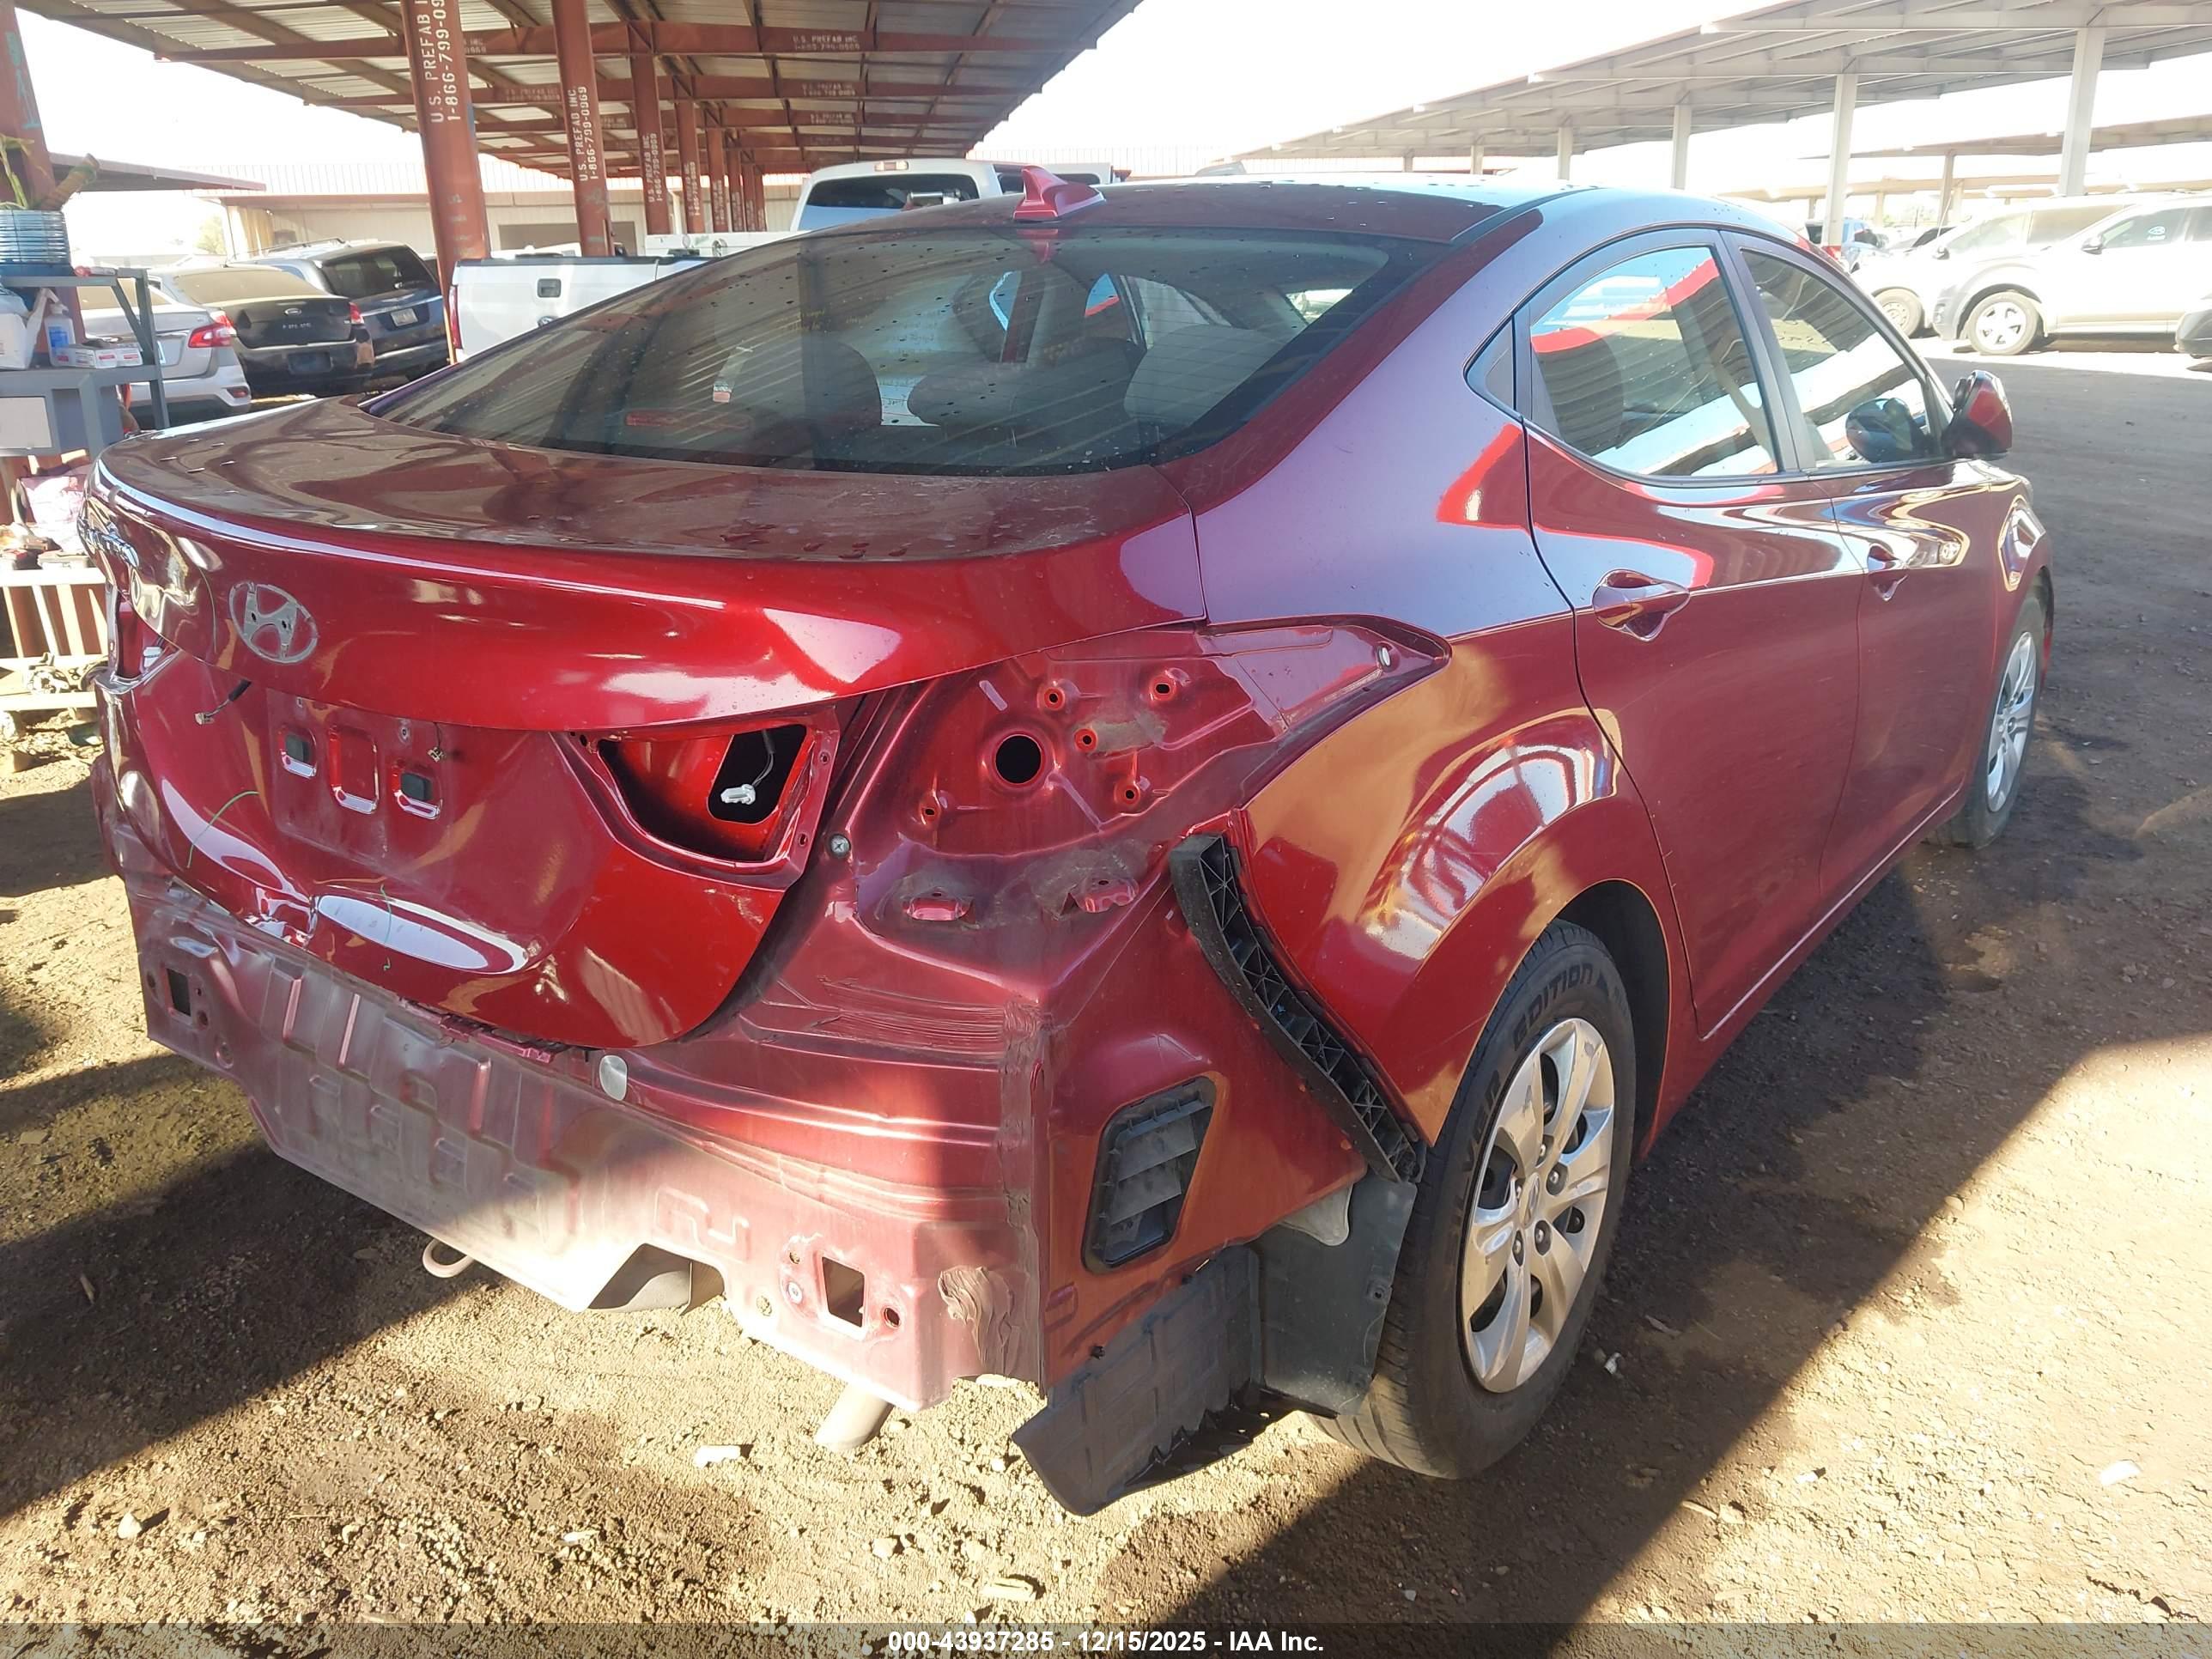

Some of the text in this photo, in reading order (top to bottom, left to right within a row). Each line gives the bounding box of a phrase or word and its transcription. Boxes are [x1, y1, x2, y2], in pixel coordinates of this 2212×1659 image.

[416, 14, 439, 81] PREFAB
[428, 90, 445, 123] U.S.
[570, 112, 585, 155] PREFAB
[577, 86, 599, 179] 1-866-799-0969
[578, 161, 588, 182] U.S.
[1513, 963, 1594, 1051] EDITION
